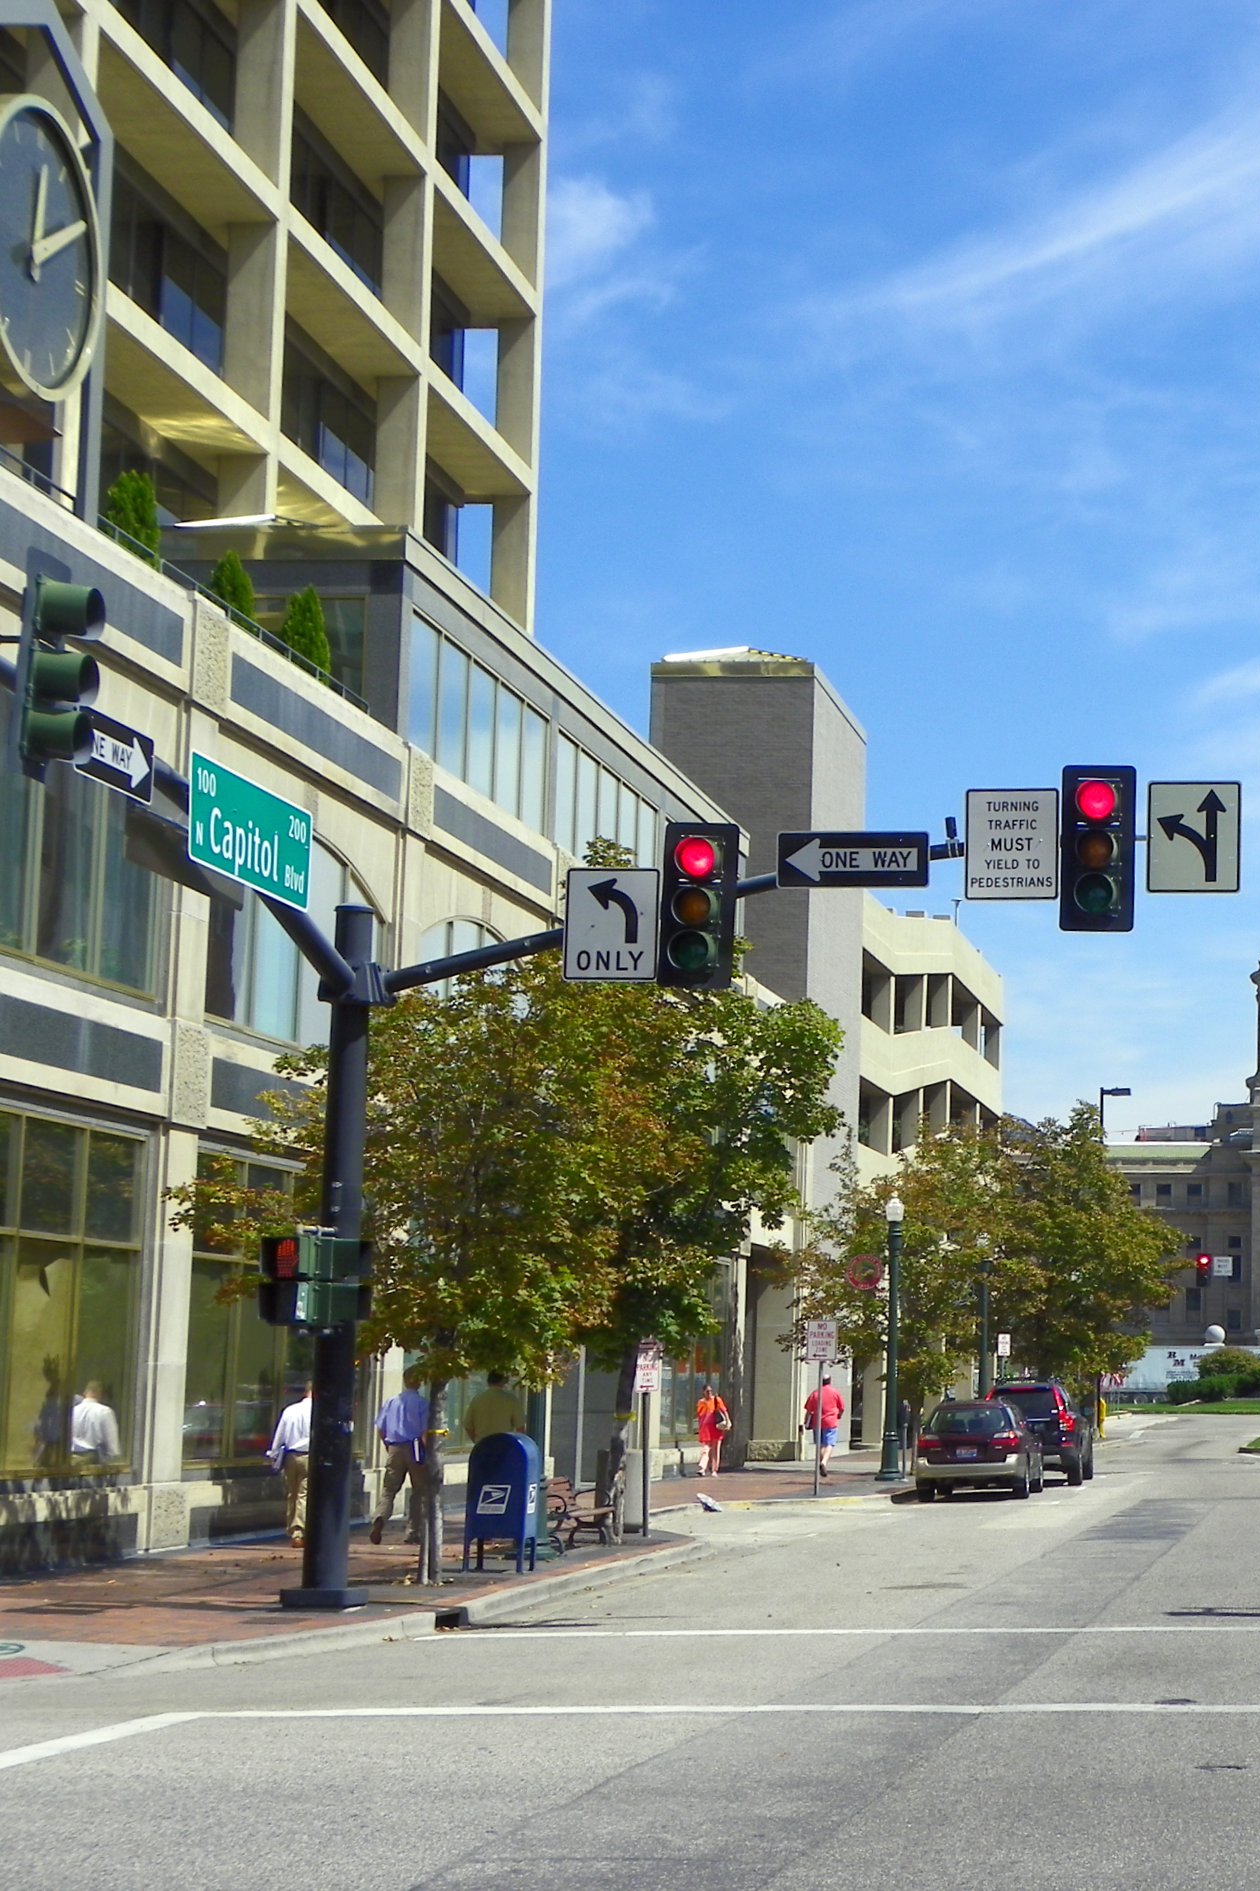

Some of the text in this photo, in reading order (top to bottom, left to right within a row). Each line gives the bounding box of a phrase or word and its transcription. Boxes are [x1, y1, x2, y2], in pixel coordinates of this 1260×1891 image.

[111, 741, 133, 771] WAY
[197, 766, 217, 798] 100
[986, 801, 1039, 812] TURNING
[288, 814, 307, 844] 200
[988, 819, 1037, 830] TRAFFIC
[195, 806, 305, 895] N Capitol Blvd
[990, 837, 1033, 852] MUST
[821, 850, 912, 869] ONE WAY
[984, 859, 1041, 870] YIELD TO
[970, 876, 1053, 888] PEDESTRIANS
[576, 949, 645, 972] ONLY
[816, 1322, 828, 1330] NO
[809, 1331, 835, 1339] PARKING
